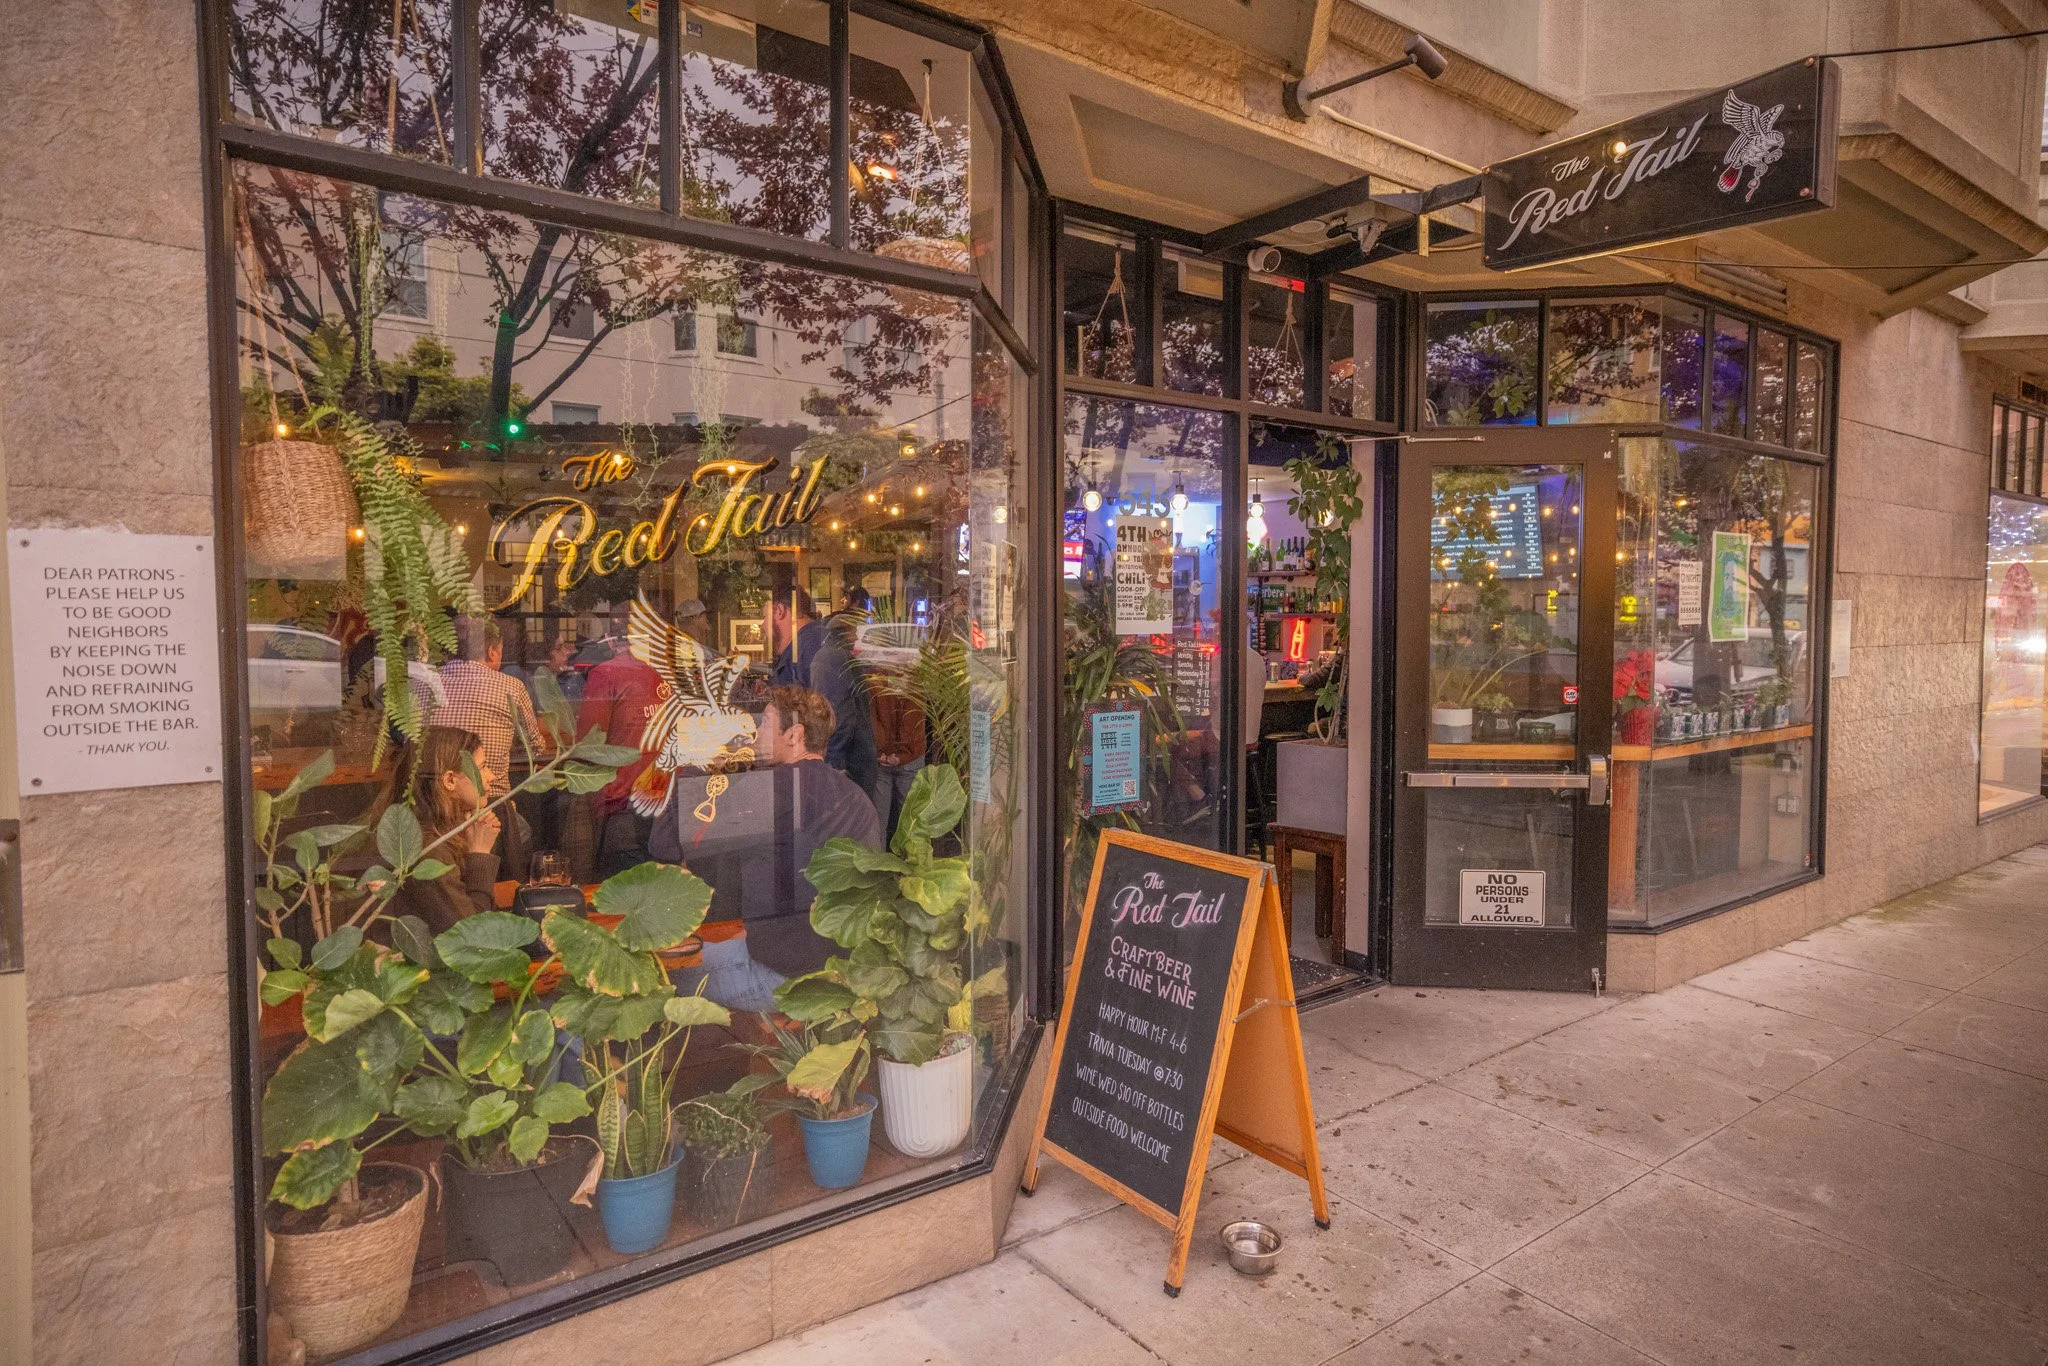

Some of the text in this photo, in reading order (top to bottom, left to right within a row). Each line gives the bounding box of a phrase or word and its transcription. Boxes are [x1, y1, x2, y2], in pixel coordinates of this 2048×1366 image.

[1551, 155, 1590, 183] The
[1497, 112, 1710, 251] Red Tail
[561, 449, 640, 491] The
[488, 453, 831, 615] Red Tail
[1117, 526, 1146, 542] 4TH
[44, 567, 92, 580] DEAR
[98, 568, 175, 581] PATRONS
[46, 587, 185, 600] PLEASE HELP US
[62, 606, 171, 619] TO BE GOOD
[68, 625, 168, 638] NEIGHBORS
[50, 643, 187, 659] BY KEEPING THE
[1178, 652, 1193, 660] Monday
[63, 663, 177, 678] NOISE DOWN
[1178, 661, 1193, 669] Tuesday
[46, 680, 194, 698] AND REFRAINING
[52, 699, 190, 717] FROM SMOKING
[43, 717, 199, 737] OUTSIDE THE BAR.
[87, 742, 135, 756] THANK
[138, 740, 170, 752] YOU.
[1143, 872, 1165, 890] The
[1488, 874, 1517, 884] NO
[1476, 885, 1529, 896] PERSONS
[1111, 886, 1225, 928] Red Tail
[1495, 904, 1509, 914] 21
[1471, 915, 1534, 923] ALLOWED
[1111, 936, 1192, 986] CRAFT BEER
[1104, 957, 1197, 1010] & FINE WINE
[1099, 1002, 1187, 1054] HAPPY HOUR M-F 4-6
[1088, 1032, 1114, 1059] TRIVIA
[1117, 1045, 1152, 1075] TUESDAY
[1076, 1063, 1185, 1131] WINE WED $10 OFF BOTTLES
[1072, 1097, 1171, 1164] OUTSIDE FOOD WELCOME
